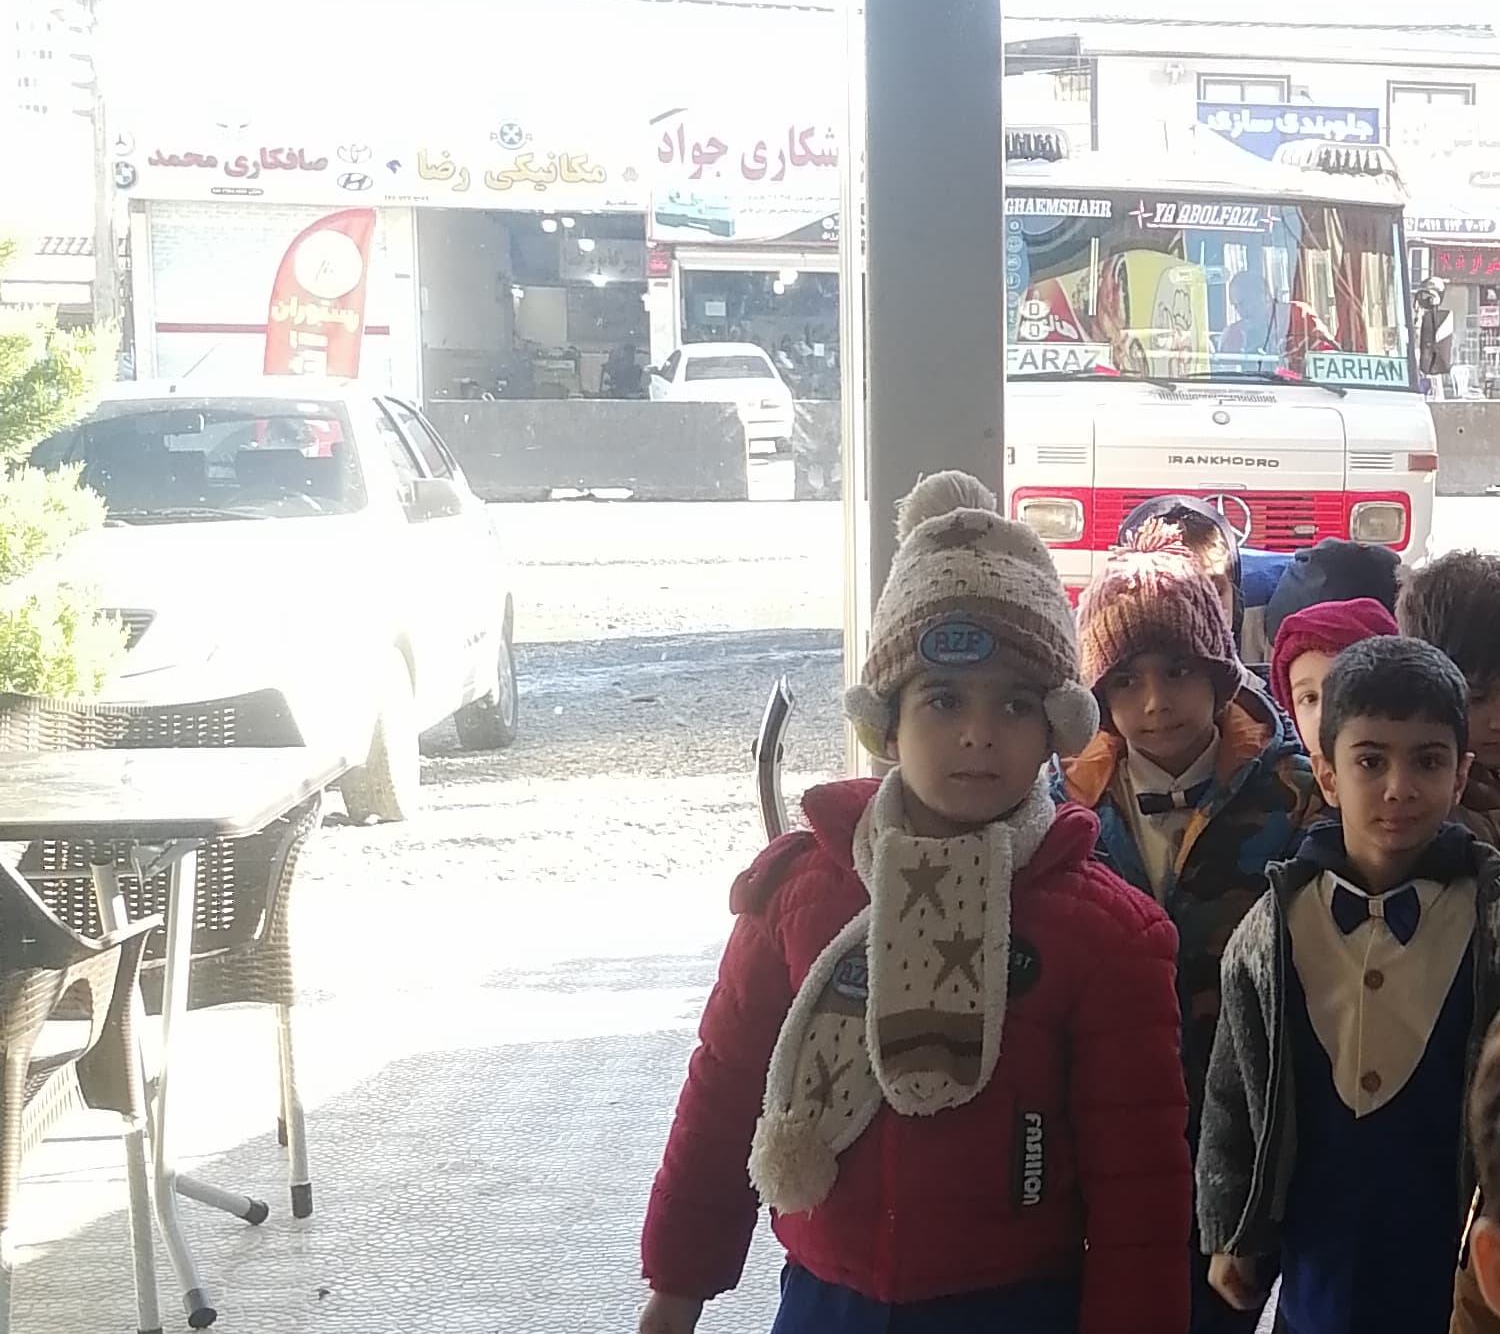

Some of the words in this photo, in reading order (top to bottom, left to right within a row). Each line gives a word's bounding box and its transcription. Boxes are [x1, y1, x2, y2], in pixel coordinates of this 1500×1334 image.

[147, 148, 218, 169] محمد
[223, 146, 329, 180] صافکاری
[657, 122, 729, 180] جواد
[416, 148, 472, 192] رضا
[484, 150, 608, 191] مکانیکی
[271, 295, 360, 333] رستوران
[1312, 357, 1404, 382] FARHAN
[1168, 455, 1280, 468] IRANKHODRO
